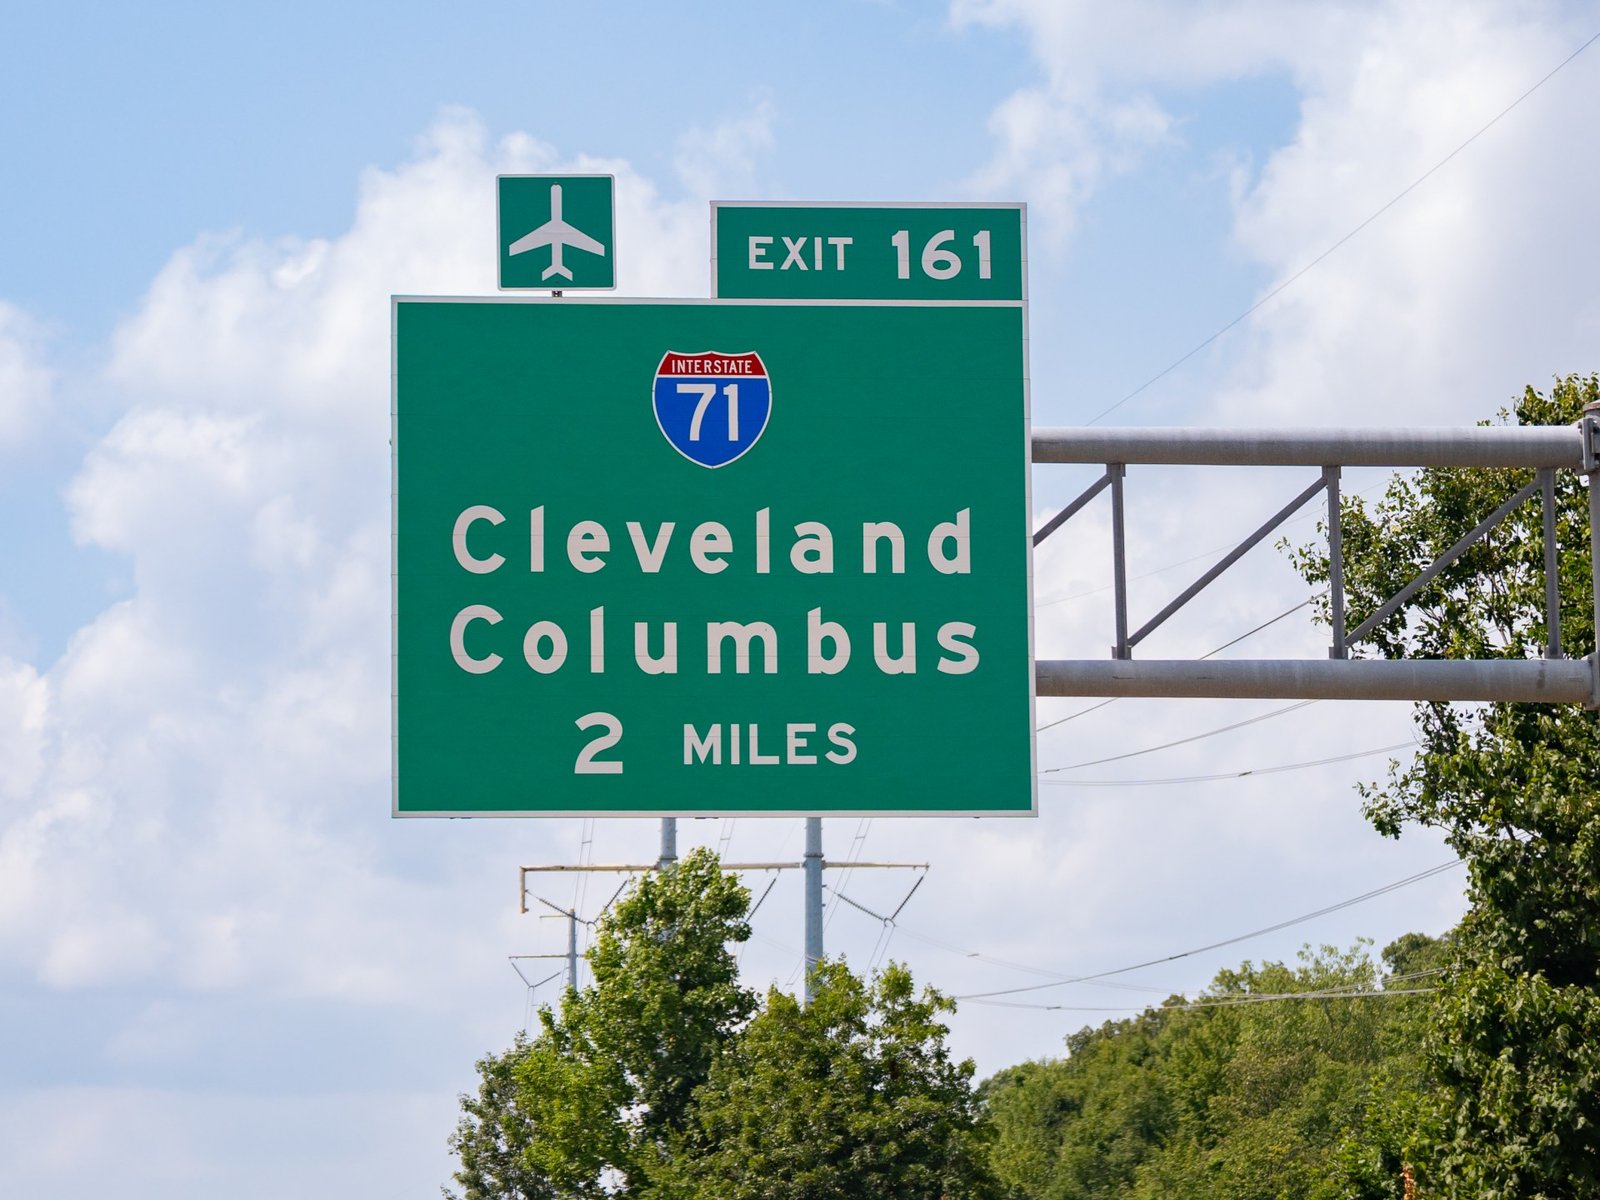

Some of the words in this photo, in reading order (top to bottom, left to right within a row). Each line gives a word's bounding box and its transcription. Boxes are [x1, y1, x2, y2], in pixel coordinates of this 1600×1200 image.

[748, 236, 853, 271] EXIT
[891, 229, 991, 280] 161
[671, 359, 753, 375] INTERSTATE
[676, 383, 739, 441] 71
[452, 505, 971, 575] Cleveland
[449, 604, 980, 675] Columbus
[574, 711, 623, 775] 2
[683, 722, 857, 766] MILES
